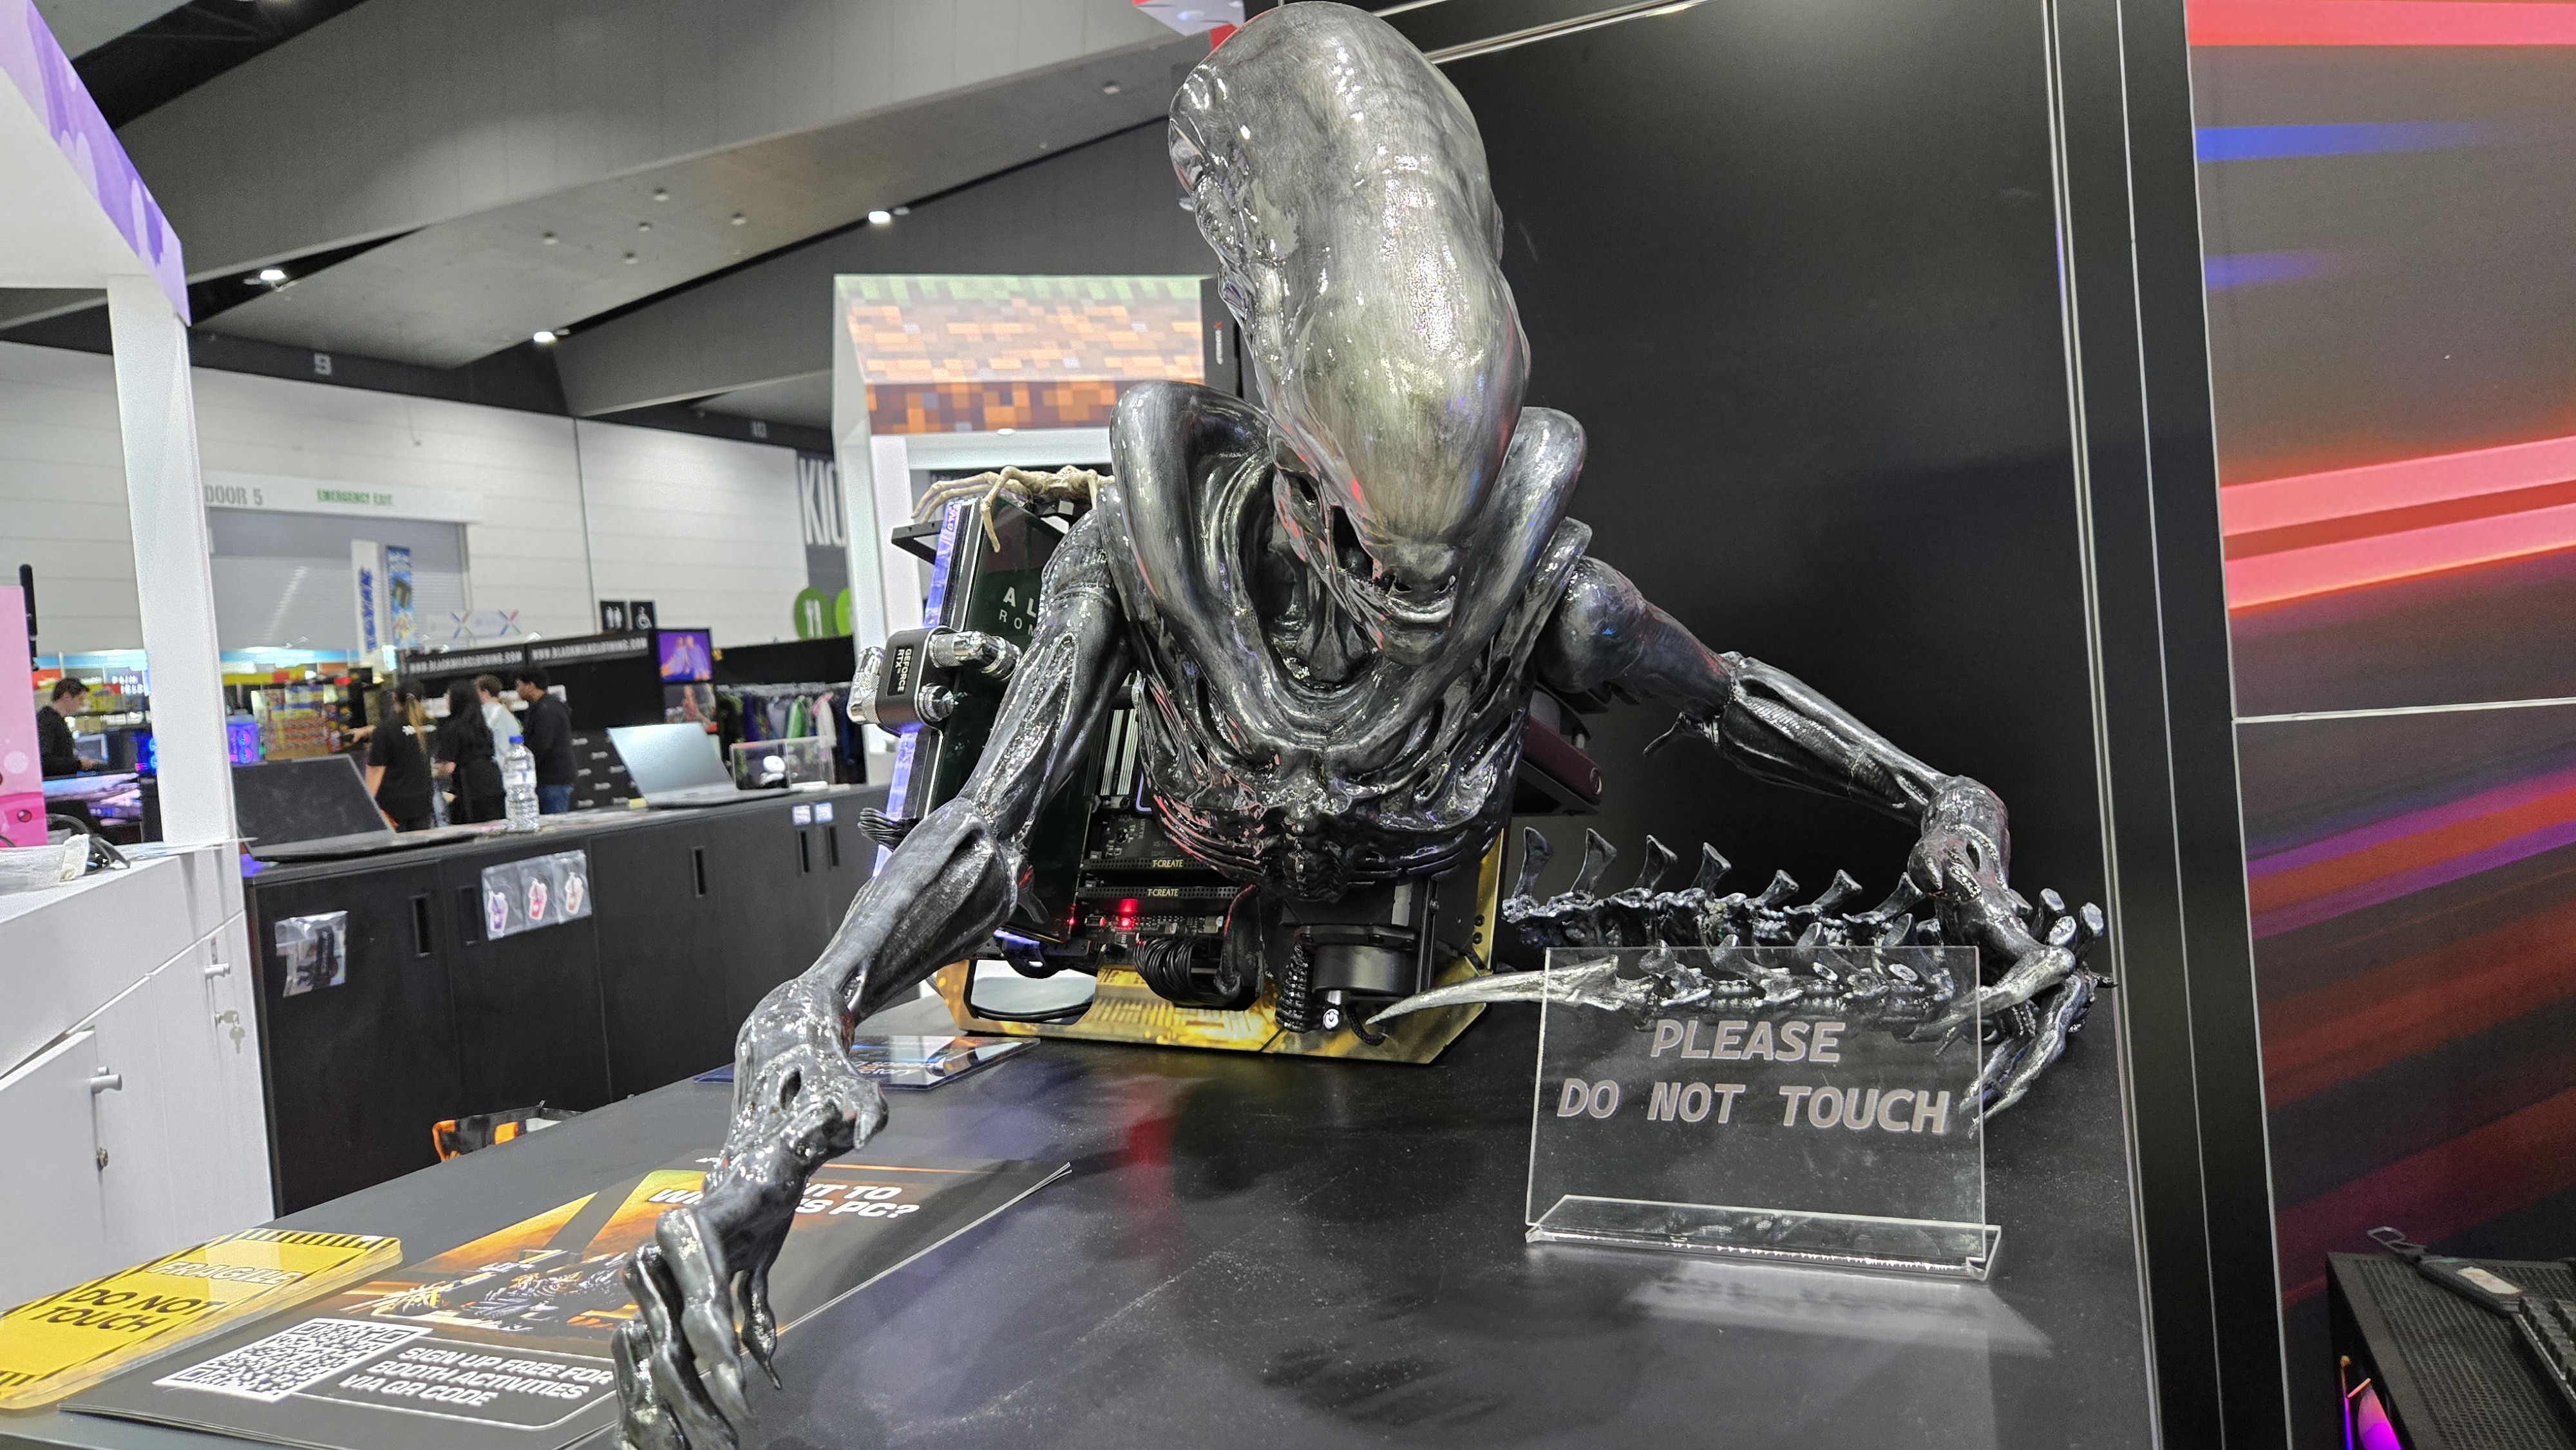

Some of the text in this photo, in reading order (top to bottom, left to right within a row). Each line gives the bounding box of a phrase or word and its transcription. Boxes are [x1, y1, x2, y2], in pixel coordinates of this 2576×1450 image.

[204, 484, 263, 505] DOOR 5
[897, 648, 912, 692] GEFORCE
[1152, 859, 1184, 868] T-CREATE
[1147, 888, 1179, 897] T-CREATE
[1650, 1019, 1846, 1062] PLEASE
[1557, 1078, 1951, 1134] DO NOT TOUCH
[844, 1185, 902, 1200] TO
[828, 1200, 920, 1219] PC?
[146, 1261, 306, 1285] FRAGILE
[65, 1288, 227, 1315] DO NOT
[28, 1306, 169, 1333] TOUCH
[397, 1347, 614, 1384] SIGN UP FREE FOR
[338, 1374, 500, 1407] VIA QR CODE
[366, 1361, 590, 1400] BOOTH ACTIVITIES
